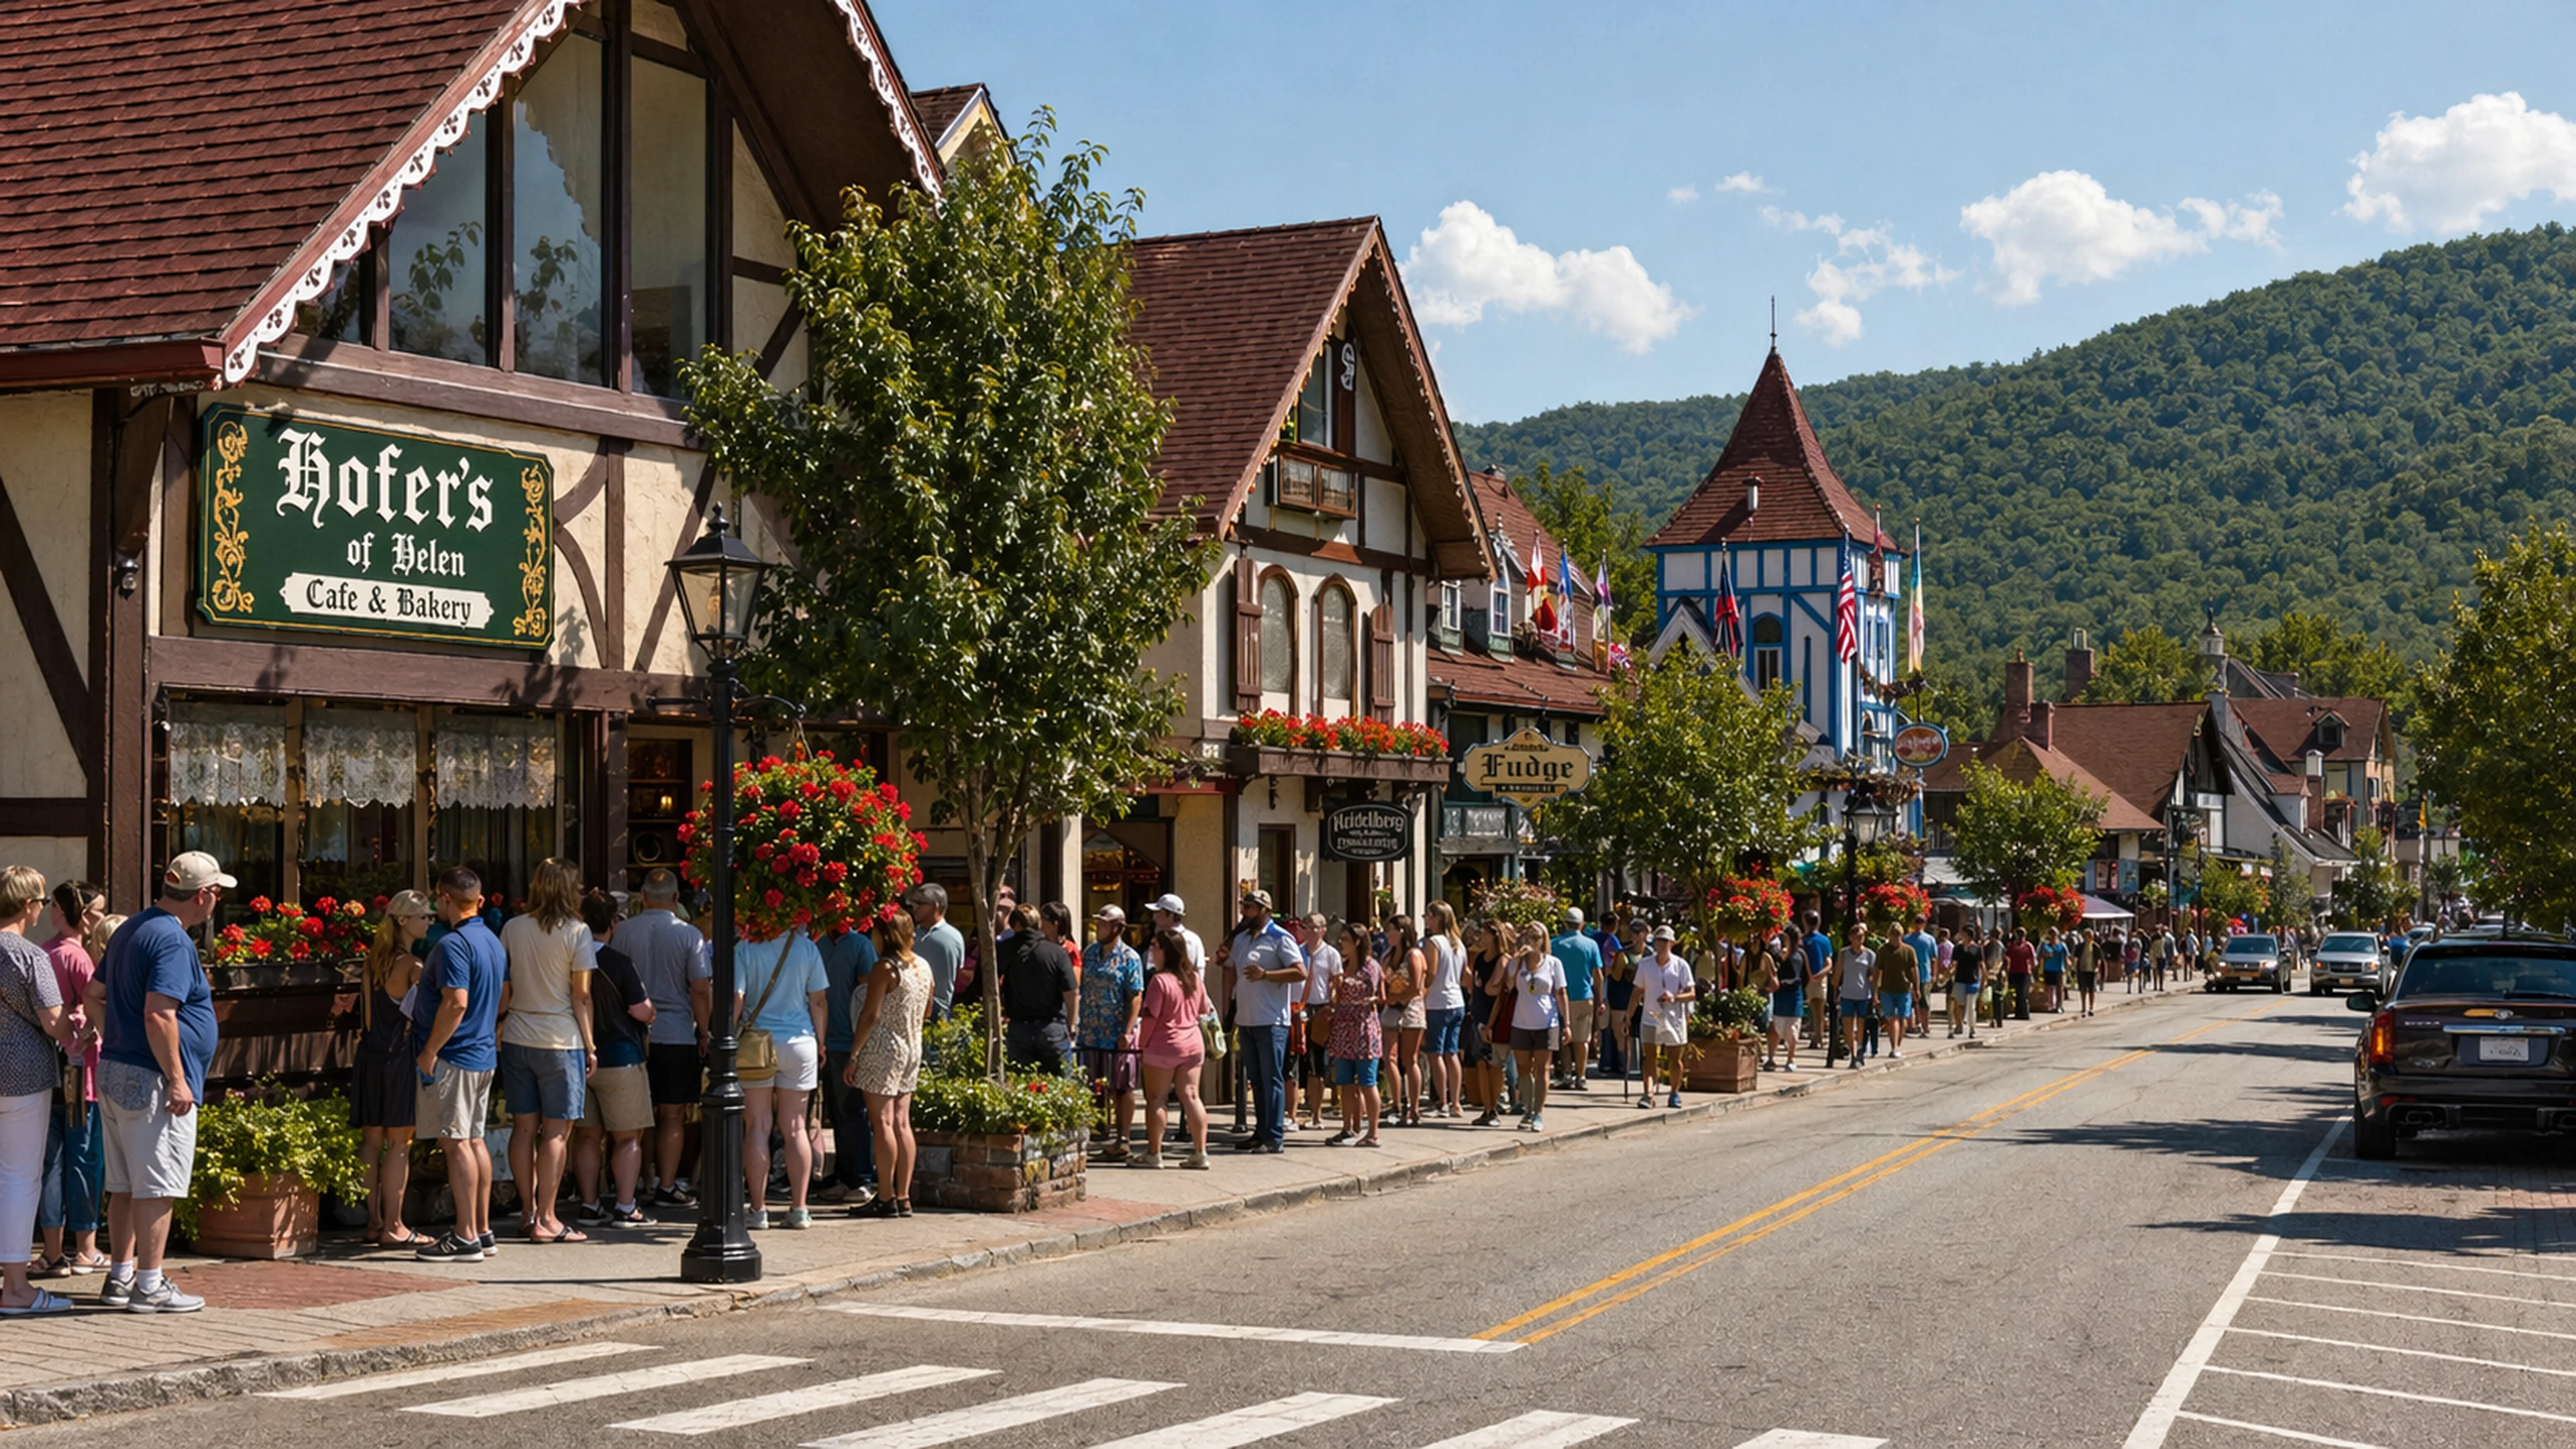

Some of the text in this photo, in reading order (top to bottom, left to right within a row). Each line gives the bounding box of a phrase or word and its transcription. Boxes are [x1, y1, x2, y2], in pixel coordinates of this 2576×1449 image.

[276, 427, 494, 533] Hofer's
[346, 531, 466, 578] of Helen
[306, 578, 471, 626] Cafe & Bakery
[1481, 753, 1574, 783] Fudge
